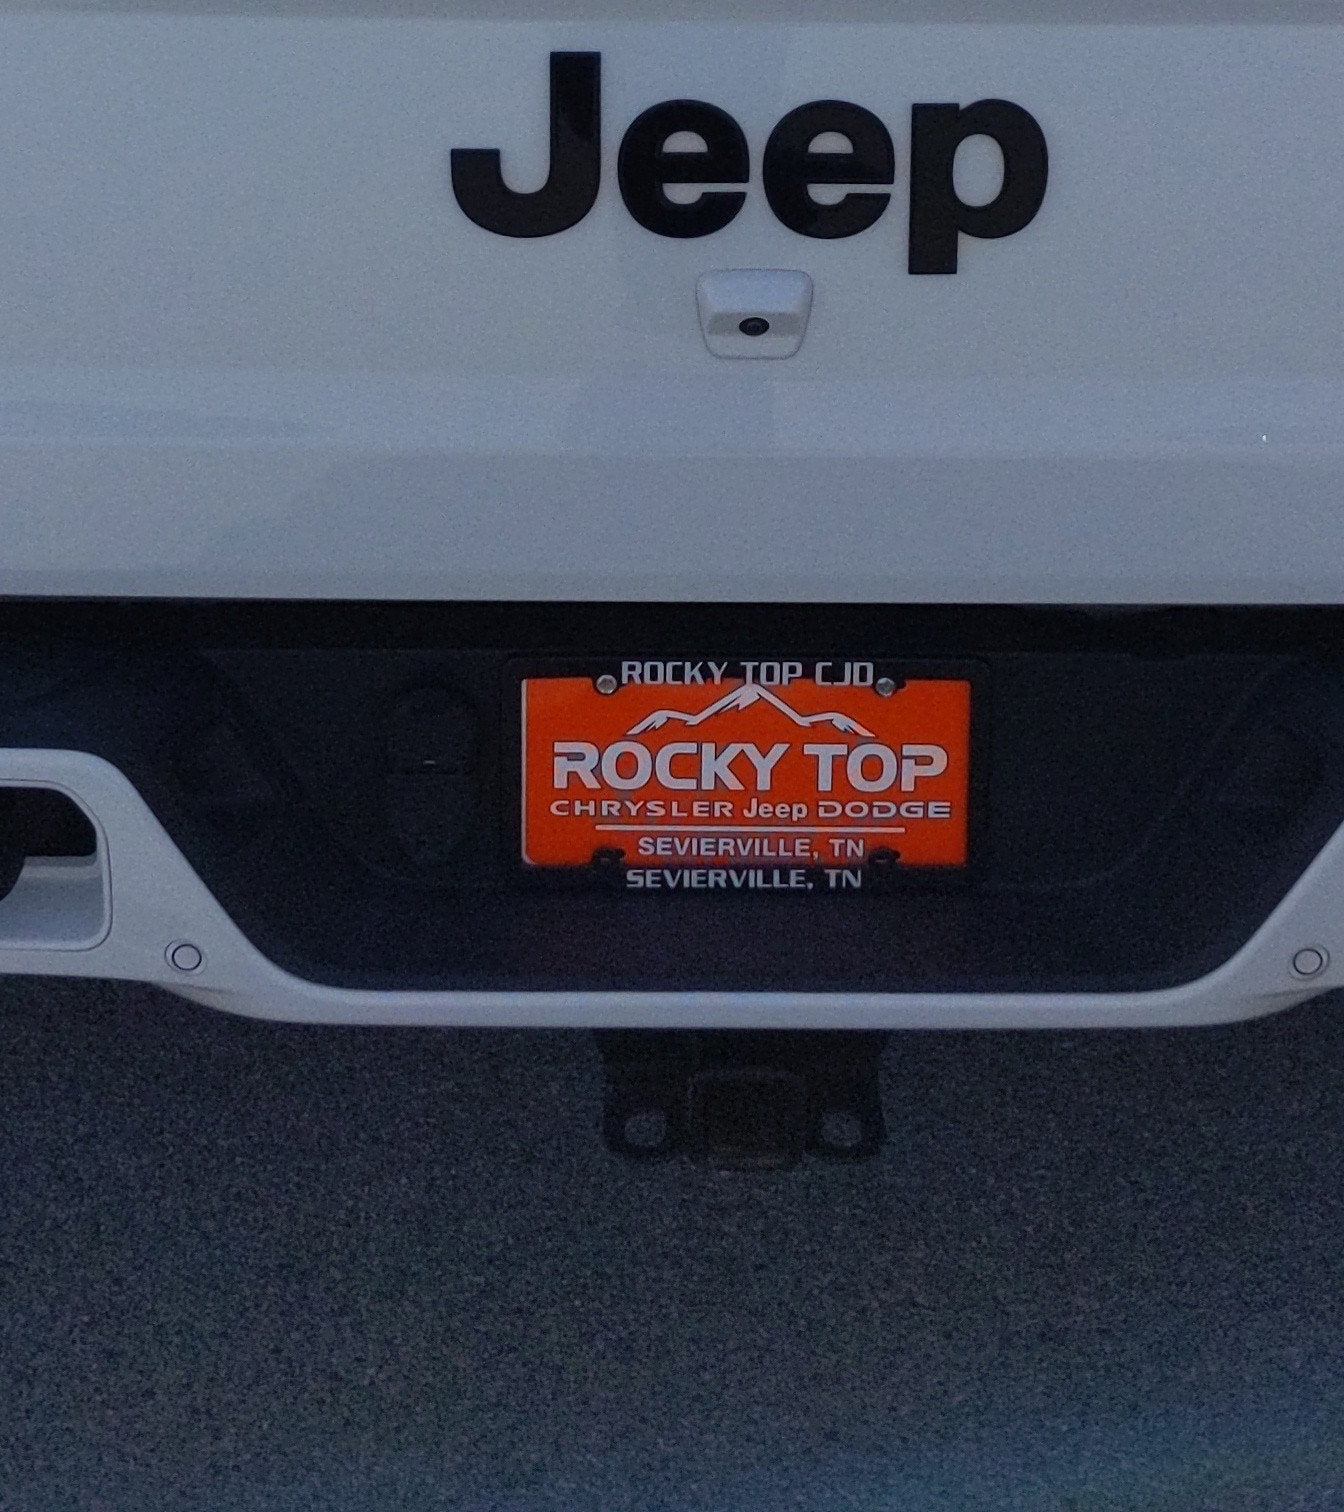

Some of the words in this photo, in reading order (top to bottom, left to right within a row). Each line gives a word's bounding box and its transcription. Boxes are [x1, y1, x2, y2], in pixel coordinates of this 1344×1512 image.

[450, 51, 1050, 275] Jeep
[620, 660, 729, 686] ROCKY
[739, 661, 803, 687] TOP
[815, 661, 875, 687] CJD
[552, 740, 791, 791] ROCKY
[803, 742, 949, 792] TOP
[549, 799, 734, 819] CHRYSLER
[742, 797, 808, 822] Jeep
[817, 800, 952, 819] DODGE
[637, 836, 820, 860] SEVIERVILLE,
[828, 838, 866, 858] TN
[625, 868, 815, 890] SEVIERVILLE,
[824, 869, 863, 888] TN
